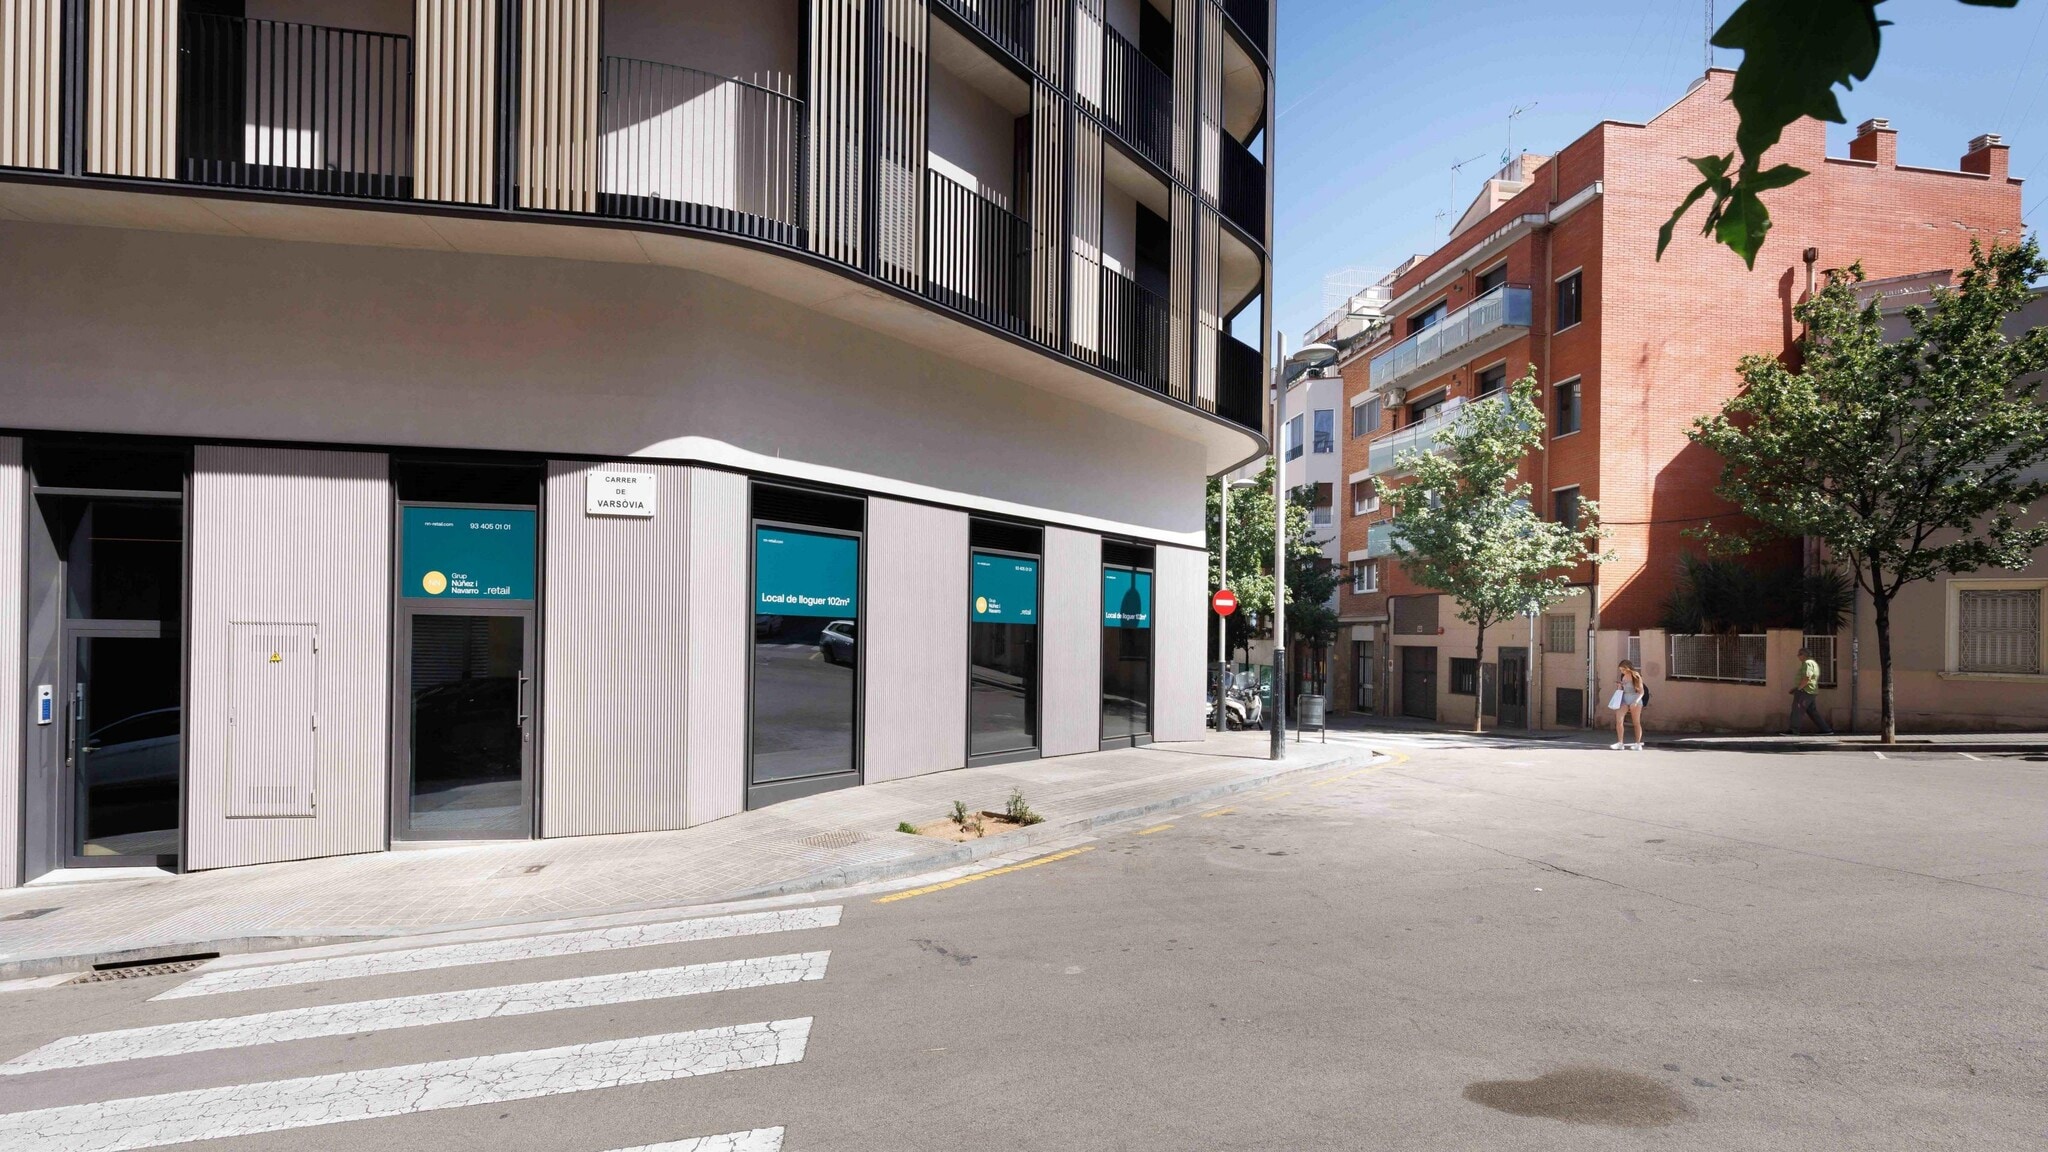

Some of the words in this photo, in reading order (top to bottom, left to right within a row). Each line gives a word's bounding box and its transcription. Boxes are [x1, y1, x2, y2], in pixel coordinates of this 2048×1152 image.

[605, 476, 637, 484] CARRER
[597, 498, 644, 509] VARSÒVIA
[469, 522, 479, 530] 93
[503, 523, 511, 531] 01
[451, 572, 468, 580] Grup
[451, 579, 475, 587] Núñez
[451, 587, 480, 595] Navarro
[761, 592, 785, 603] Local
[786, 594, 798, 604] de
[798, 595, 826, 607] lloguer
